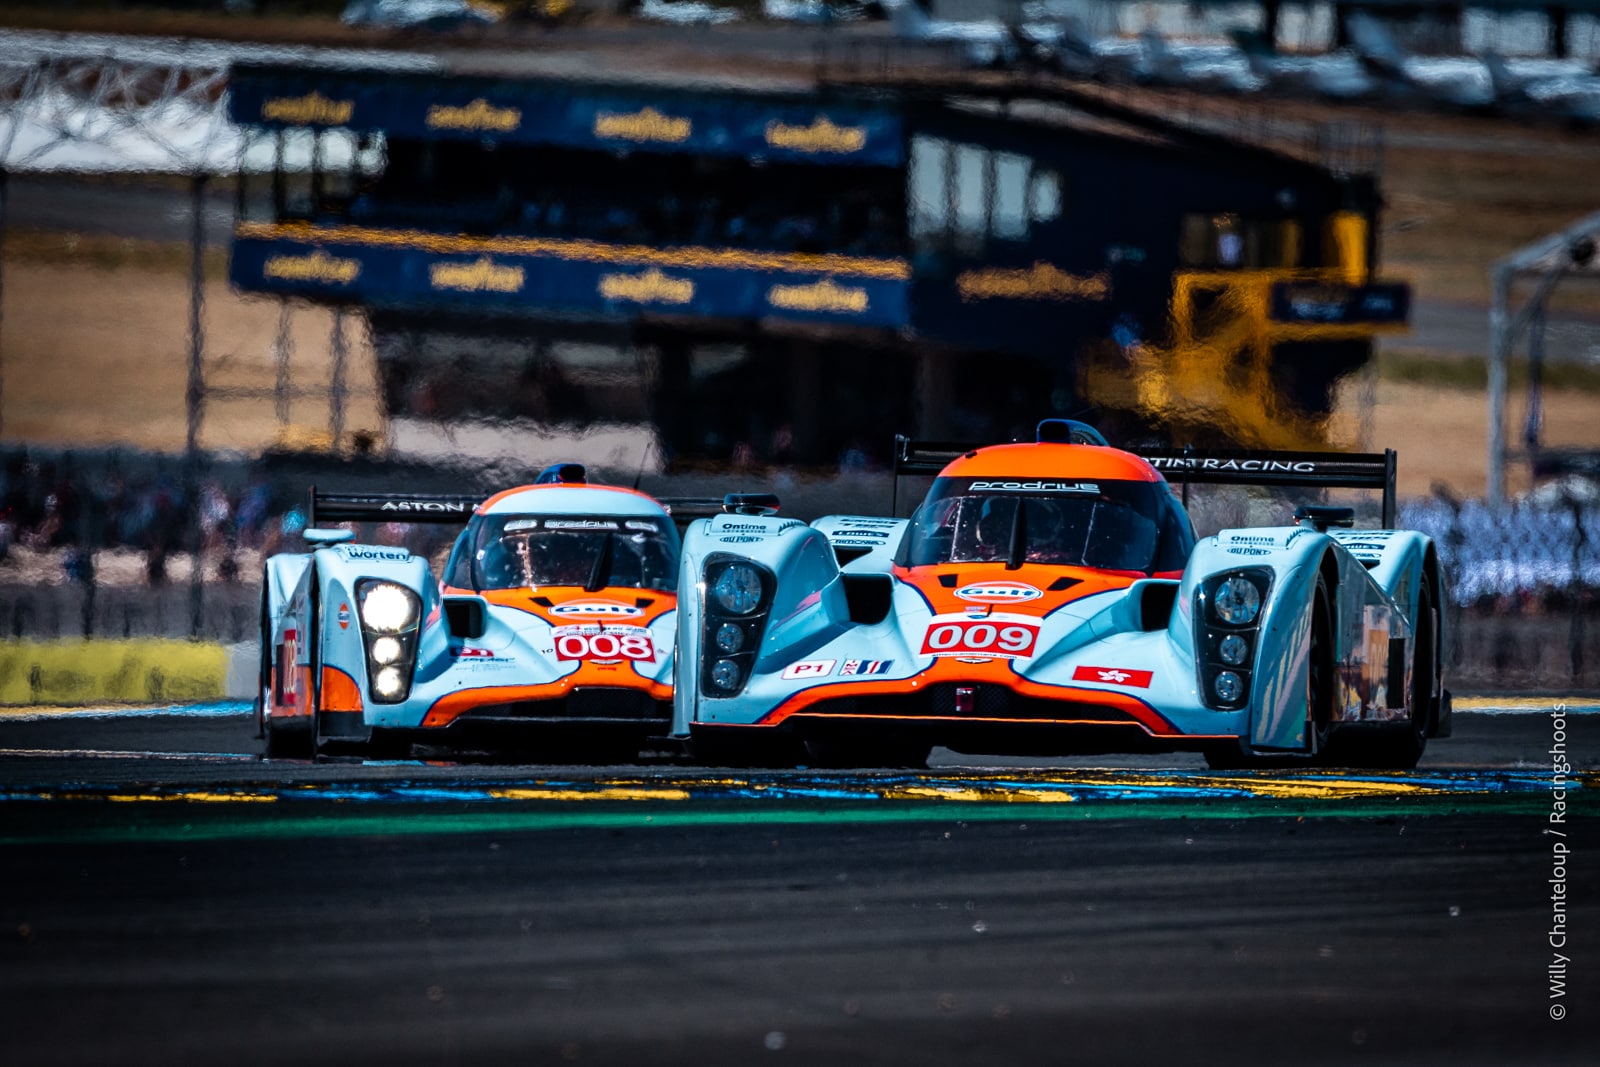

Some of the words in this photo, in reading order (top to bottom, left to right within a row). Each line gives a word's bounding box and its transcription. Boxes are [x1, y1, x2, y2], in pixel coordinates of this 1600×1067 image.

[1202, 458, 1316, 473] RACING
[380, 501, 464, 512] ASTON
[349, 551, 406, 560] worten
[961, 588, 1035, 597] Gulf
[555, 606, 637, 614] Gulf
[928, 624, 1034, 651] 009
[558, 635, 652, 659] 008
[794, 664, 824, 674] P1
